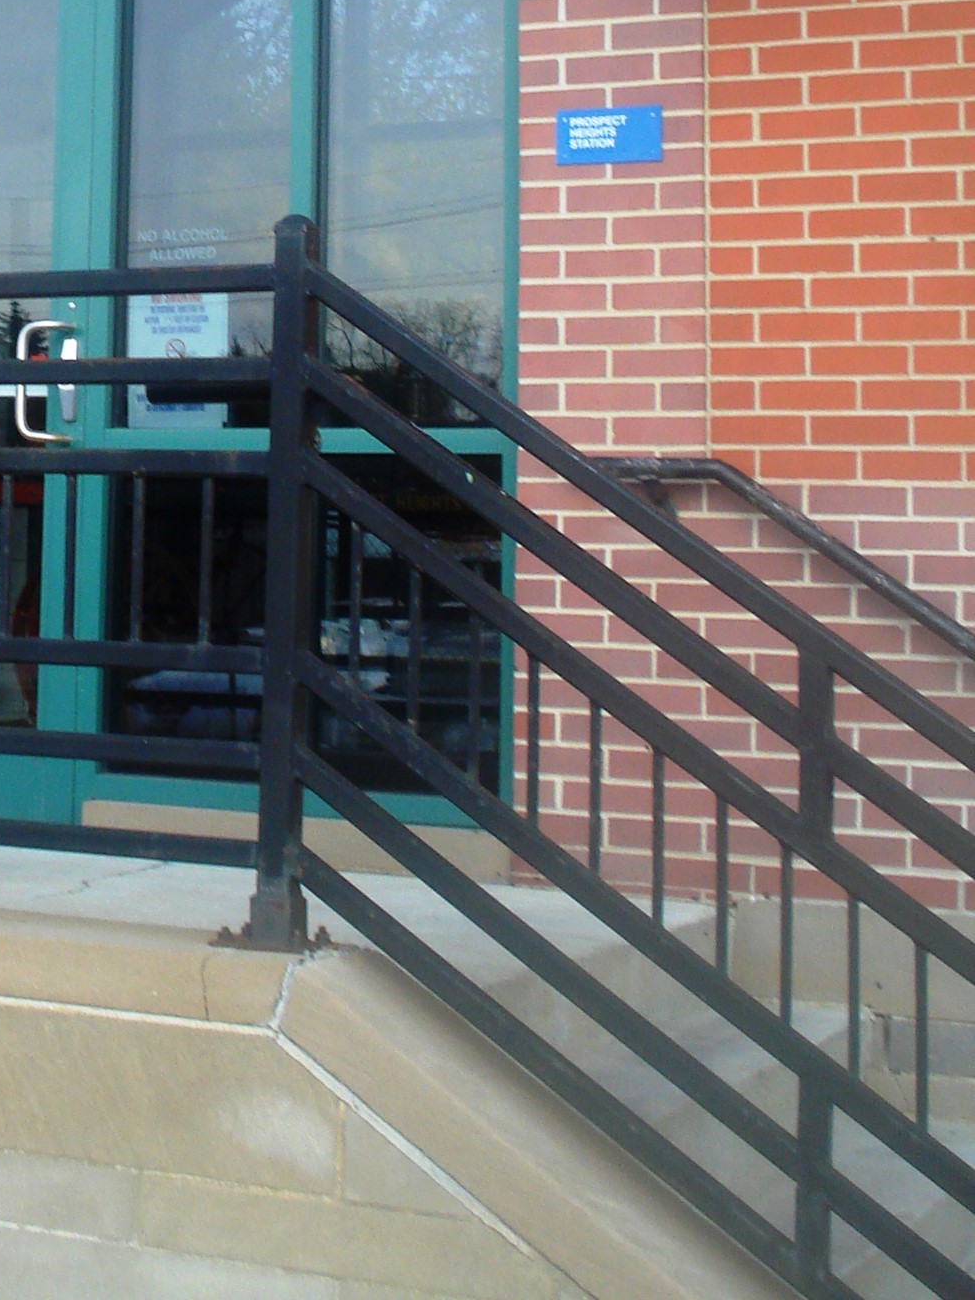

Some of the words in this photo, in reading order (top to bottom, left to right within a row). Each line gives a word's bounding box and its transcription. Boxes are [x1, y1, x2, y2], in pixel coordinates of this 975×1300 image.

[568, 115, 627, 127] PROSPECT
[568, 127, 617, 139] HEIGHTS
[568, 138, 615, 150] STATION
[136, 229, 158, 243] NO
[162, 227, 227, 243] ALCOHOL
[149, 245, 217, 262] ALLOWED
